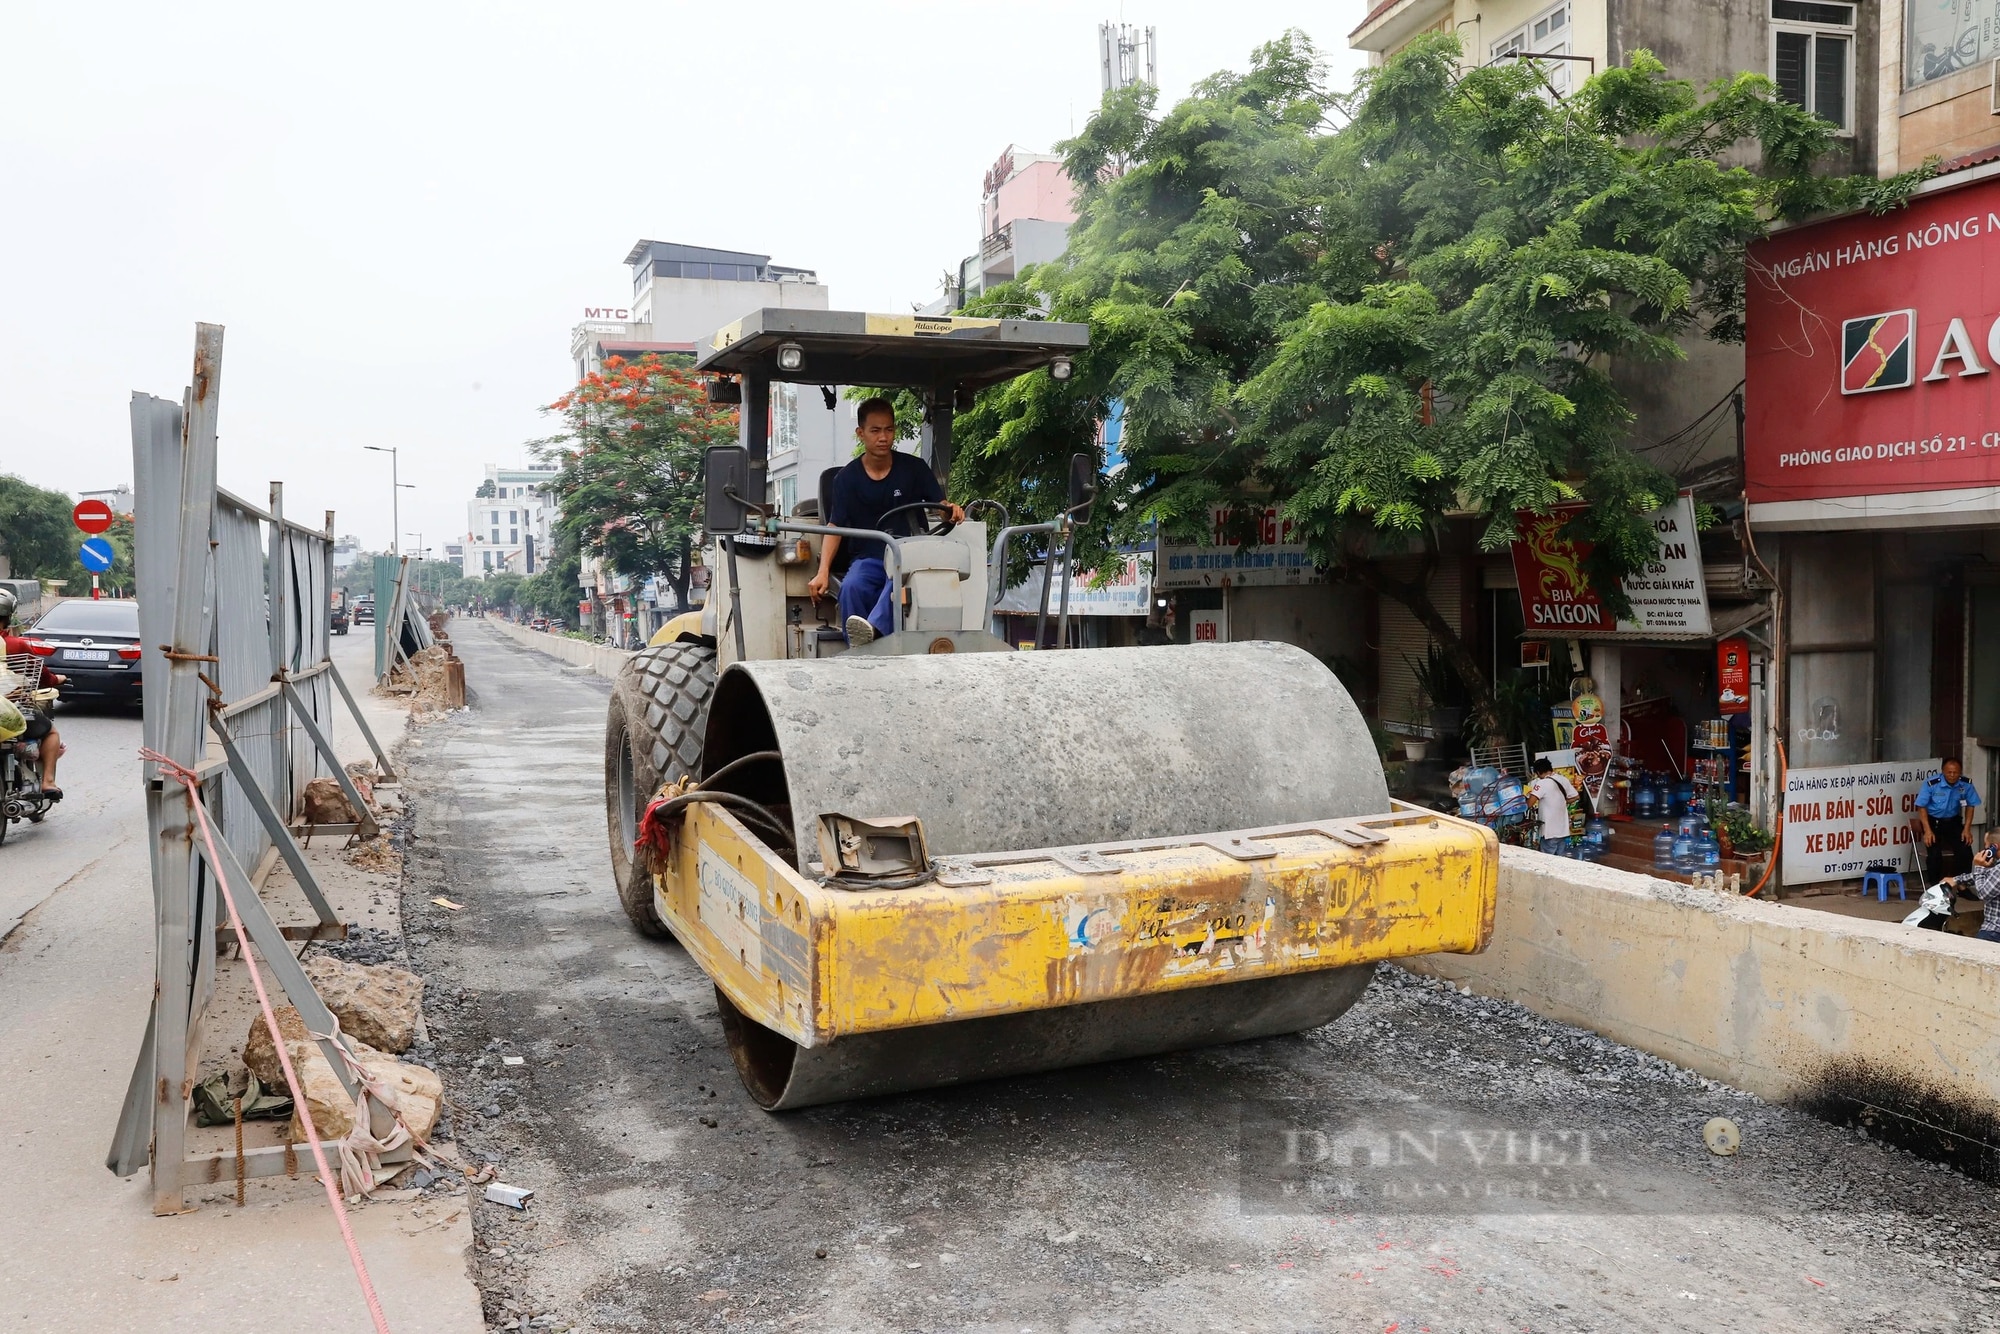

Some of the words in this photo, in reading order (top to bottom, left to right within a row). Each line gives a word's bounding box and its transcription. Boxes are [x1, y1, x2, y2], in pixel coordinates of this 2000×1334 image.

[1773, 251, 1830, 280] NGÂN
[1836, 235, 1899, 267] HÀNG
[1906, 216, 1979, 250] NÔNG
[585, 307, 629, 319] MTC
[1779, 448, 1832, 468] PHÒNG
[1835, 445, 1873, 462] GIAO
[1877, 441, 1916, 462] DỊCH
[1920, 432, 1943, 455] SỐ
[1946, 436, 1966, 452] 21
[1664, 543, 1687, 559] AN
[1647, 564, 1667, 576] GẠO
[1672, 577, 1695, 590] KHÁT
[1551, 589, 1574, 602] BIA
[1532, 603, 1601, 624] SAIGON
[1806, 776, 1828, 791] HÀNG
[1830, 777, 1839, 788] XE
[1840, 776, 1856, 789] ĐẠP
[1857, 772, 1879, 786] HOÀN
[1900, 771, 1912, 782] 473
[1915, 768, 1925, 781] ÂU
[1789, 802, 1821, 823] MUA
[1826, 796, 1855, 820] BÁN
[1866, 788, 1894, 816] SỬA
[1805, 833, 1824, 854] XE
[1826, 831, 1855, 854] ĐẠP
[1860, 824, 1888, 848] CÁC
[1867, 858, 1884, 869] 283
[1886, 857, 1902, 867] 181
